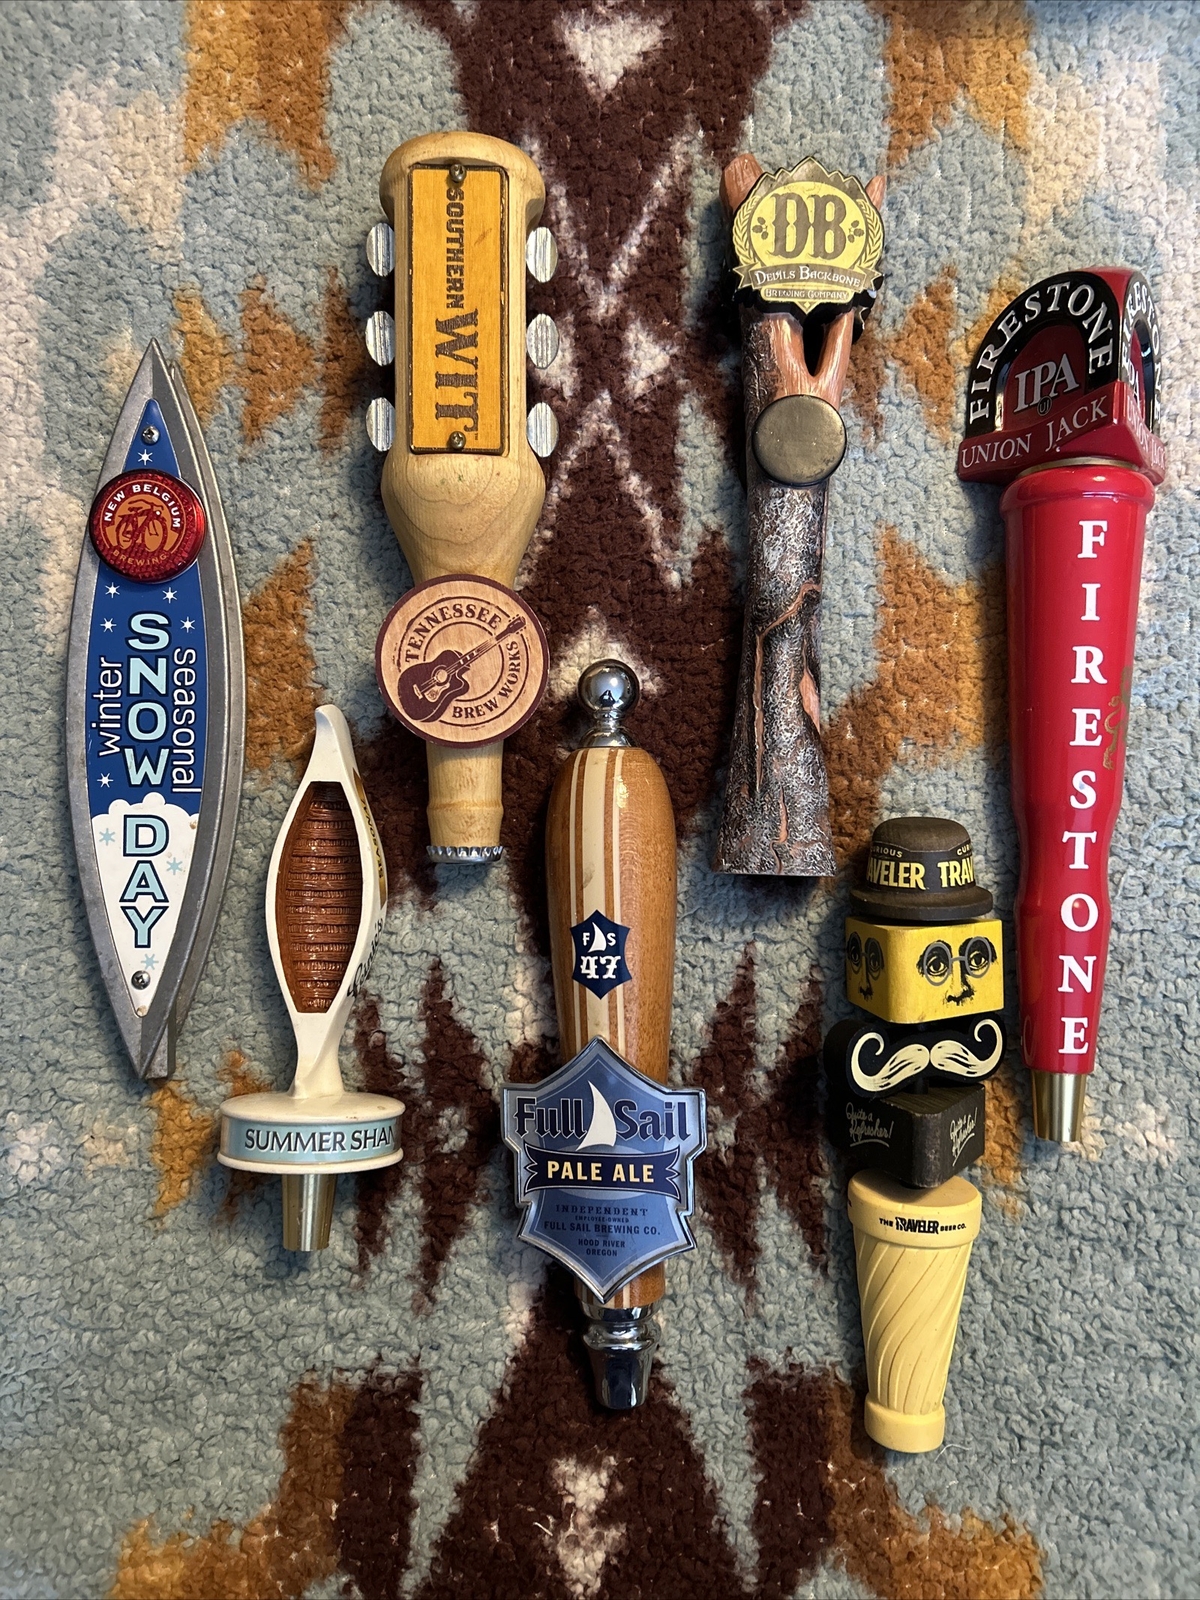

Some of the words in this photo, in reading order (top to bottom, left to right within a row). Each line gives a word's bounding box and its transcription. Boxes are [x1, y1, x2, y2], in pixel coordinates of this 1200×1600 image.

[446, 188, 464, 309] SOUTHERN
[767, 192, 847, 261] DB
[754, 269, 796, 285] DEVILS
[799, 265, 860, 287] BACKBONE
[765, 288, 805, 298] BREWING
[807, 289, 848, 299] COMPANY
[435, 309, 479, 433] WIT
[969, 282, 1113, 425] FIRESTONE
[1013, 353, 1080, 413] IPA
[961, 433, 1032, 469] UNION
[1045, 396, 1107, 452] JACK
[104, 491, 126, 522] NEW
[132, 483, 181, 528] BELGIUM
[112, 549, 168, 566] BREWING
[405, 603, 502, 663] TENNESSEE
[122, 611, 171, 789] SNOW
[452, 696, 499, 719] BREW
[498, 640, 521, 699] WORKS
[91, 655, 123, 758] winter
[171, 646, 201, 794] seasonal
[1057, 519, 1108, 1054] FIRESTONE
[121, 814, 169, 950] DAY
[583, 932, 590, 946] F
[607, 932, 617, 946] S
[580, 955, 621, 979] 47
[244, 1128, 347, 1153] SUMMER
[513, 1096, 588, 1140] Full
[613, 1098, 692, 1142] Sail
[547, 1160, 602, 1181] PALE
[612, 1163, 655, 1183] ALE
[544, 1221, 566, 1231] FULL
[570, 1222, 590, 1232] SAIL
[594, 1224, 640, 1235] BREWING
[643, 1226, 660, 1236] CO.
[556, 1204, 648, 1217] INDEPENDENT
[879, 1217, 893, 1227] THE
[895, 1216, 939, 1234] TRAVELER
[578, 1238, 600, 1247] HOOD
[602, 1239, 625, 1248] RIVER
[586, 1248, 618, 1257] OREGON
